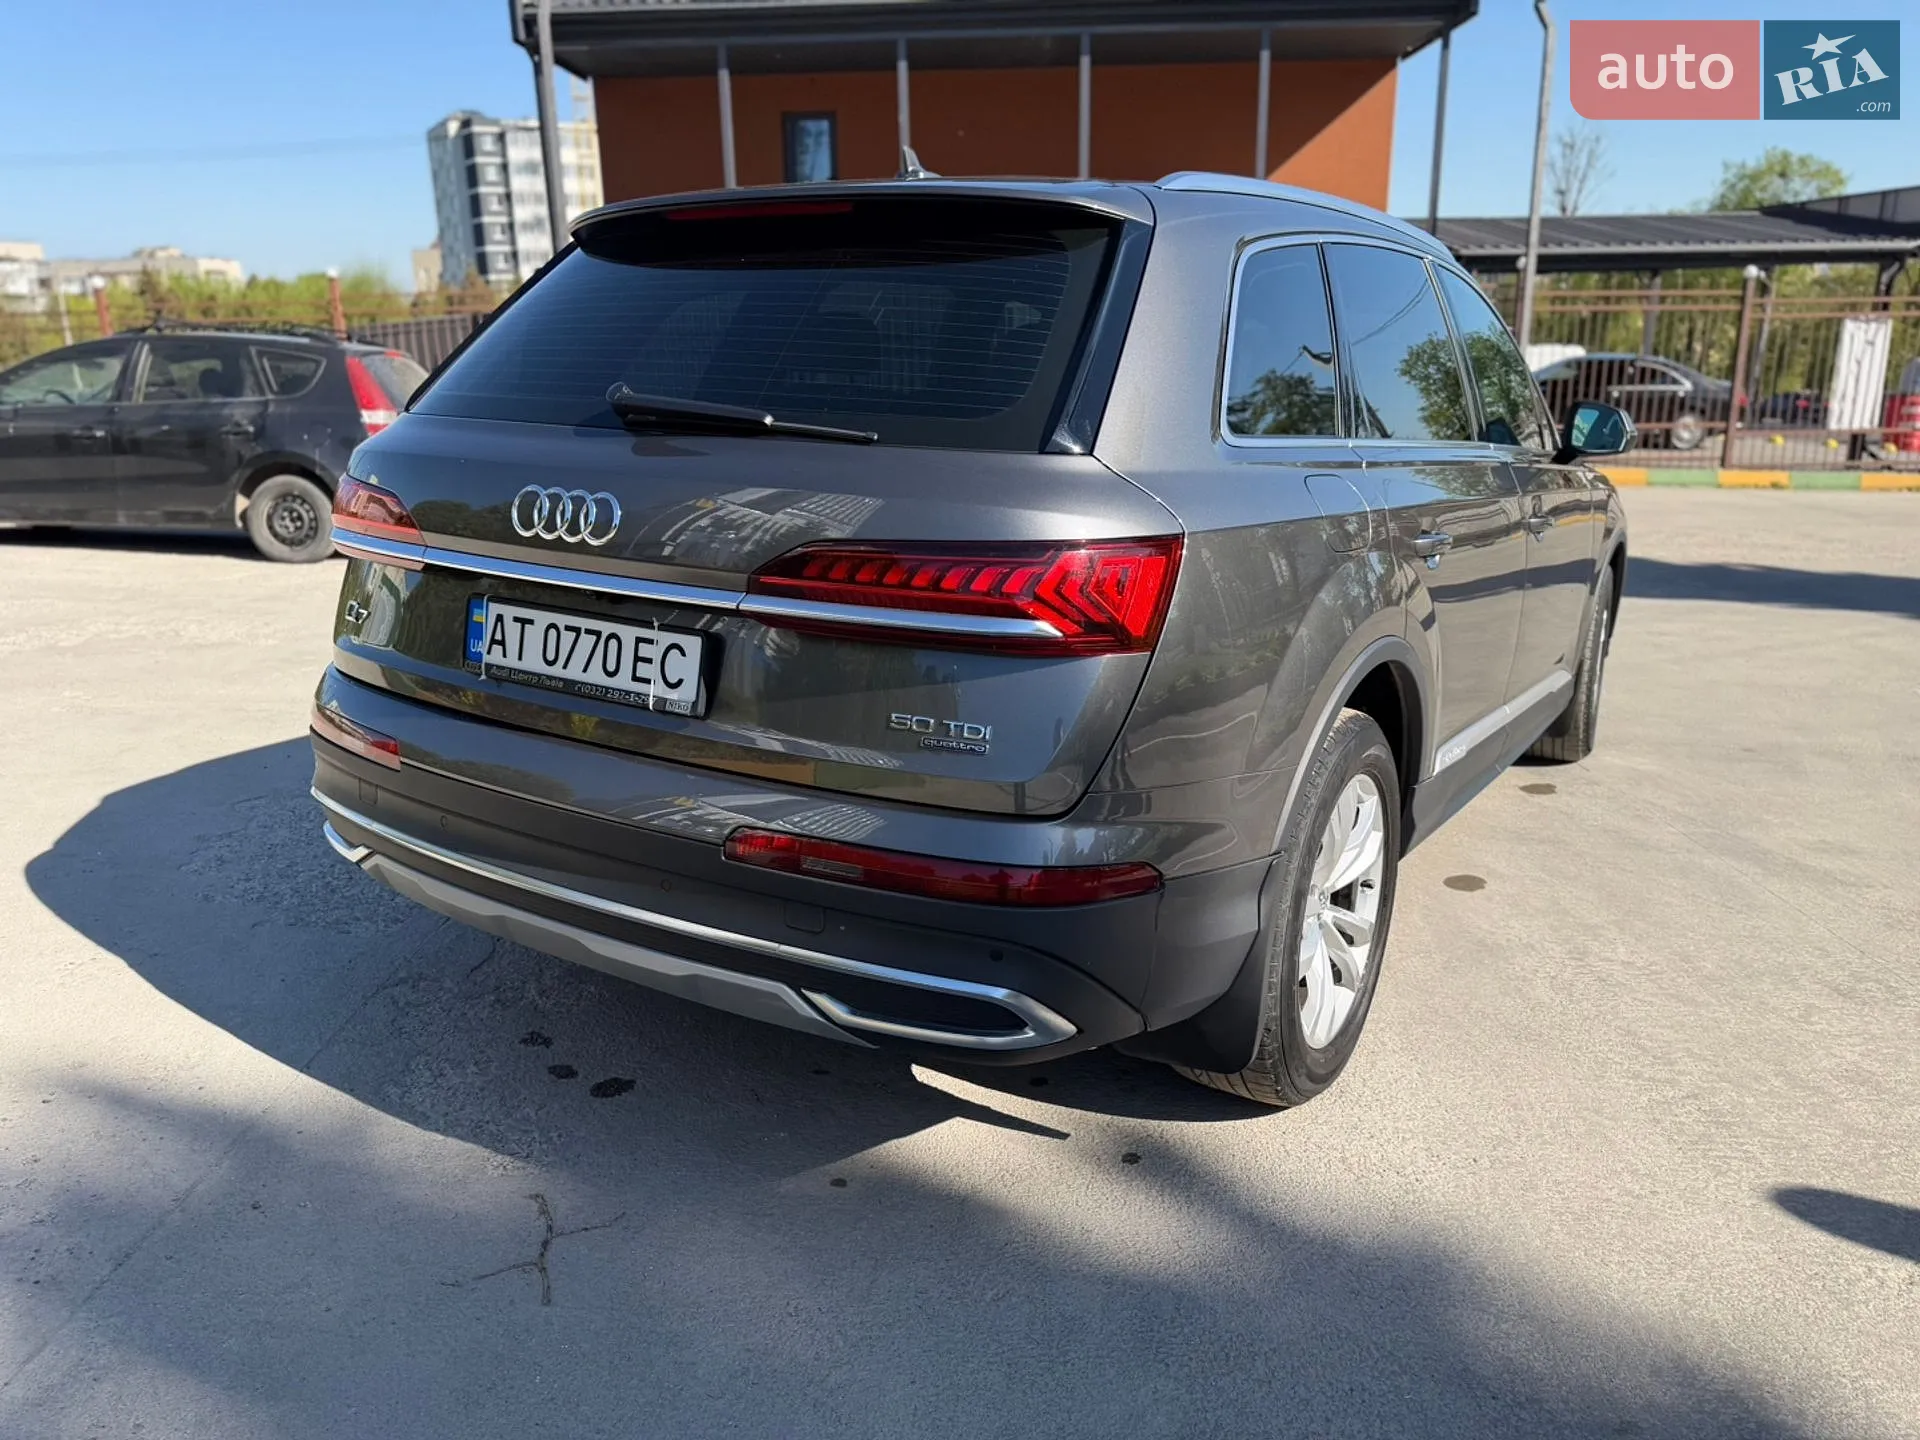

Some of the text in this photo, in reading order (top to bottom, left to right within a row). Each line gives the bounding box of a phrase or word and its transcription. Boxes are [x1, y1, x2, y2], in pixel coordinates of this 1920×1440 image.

[345, 599, 369, 624] Q7
[470, 638, 485, 654] UA
[487, 613, 687, 690] AT 0770 EC
[889, 713, 992, 741] 50 TDI
[923, 737, 986, 753] quattro
